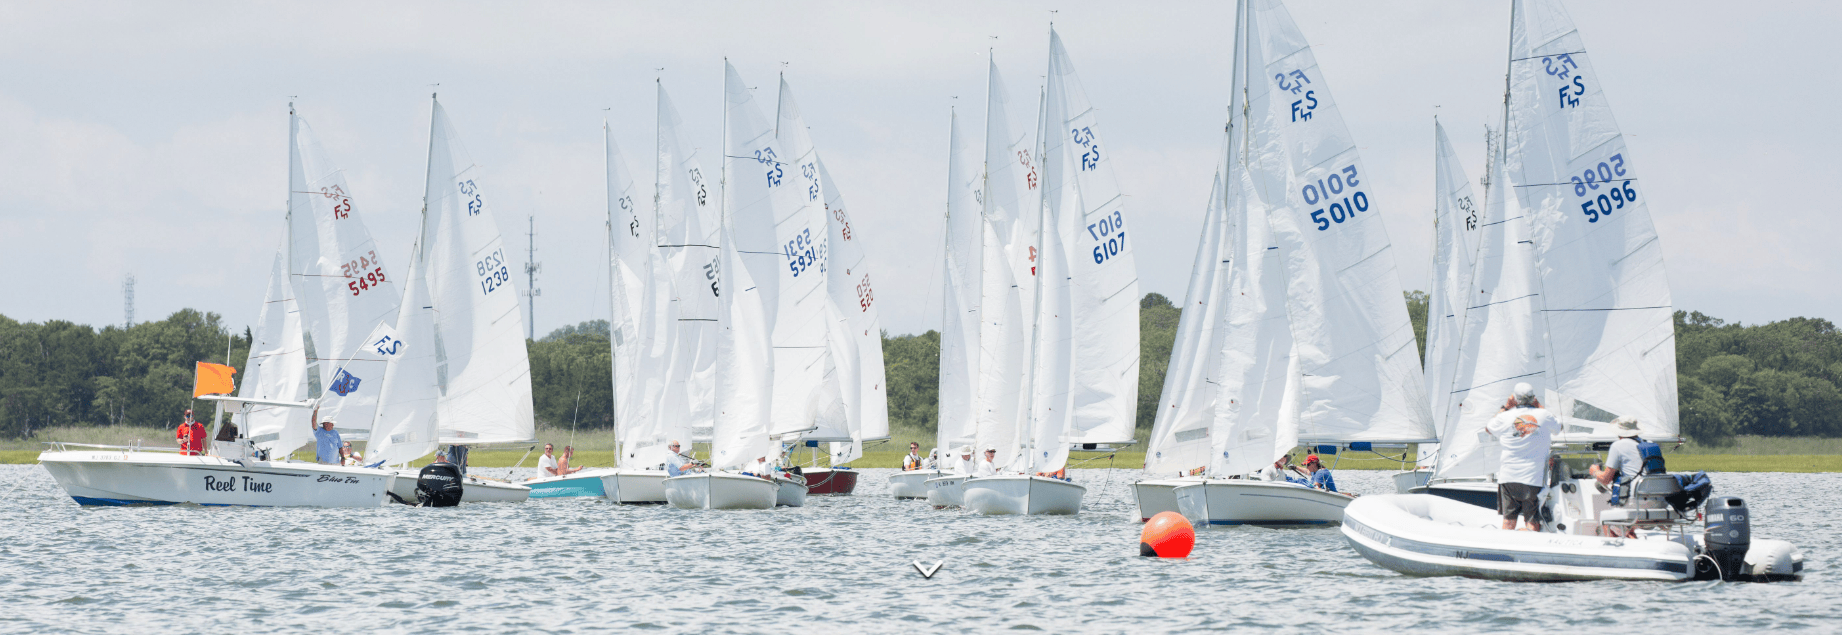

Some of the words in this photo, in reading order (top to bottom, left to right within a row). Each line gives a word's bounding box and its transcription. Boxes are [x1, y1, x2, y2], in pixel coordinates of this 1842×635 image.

[1310, 191, 1369, 231] 5010
[1581, 180, 1636, 223] 5096
[790, 246, 816, 277] 5931
[1093, 231, 1125, 264] 6107
[348, 267, 385, 296] 5495
[481, 266, 509, 295] 1238
[204, 475, 236, 491] Reel
[242, 476, 272, 493] Time
[1455, 550, 1469, 559] NJ
